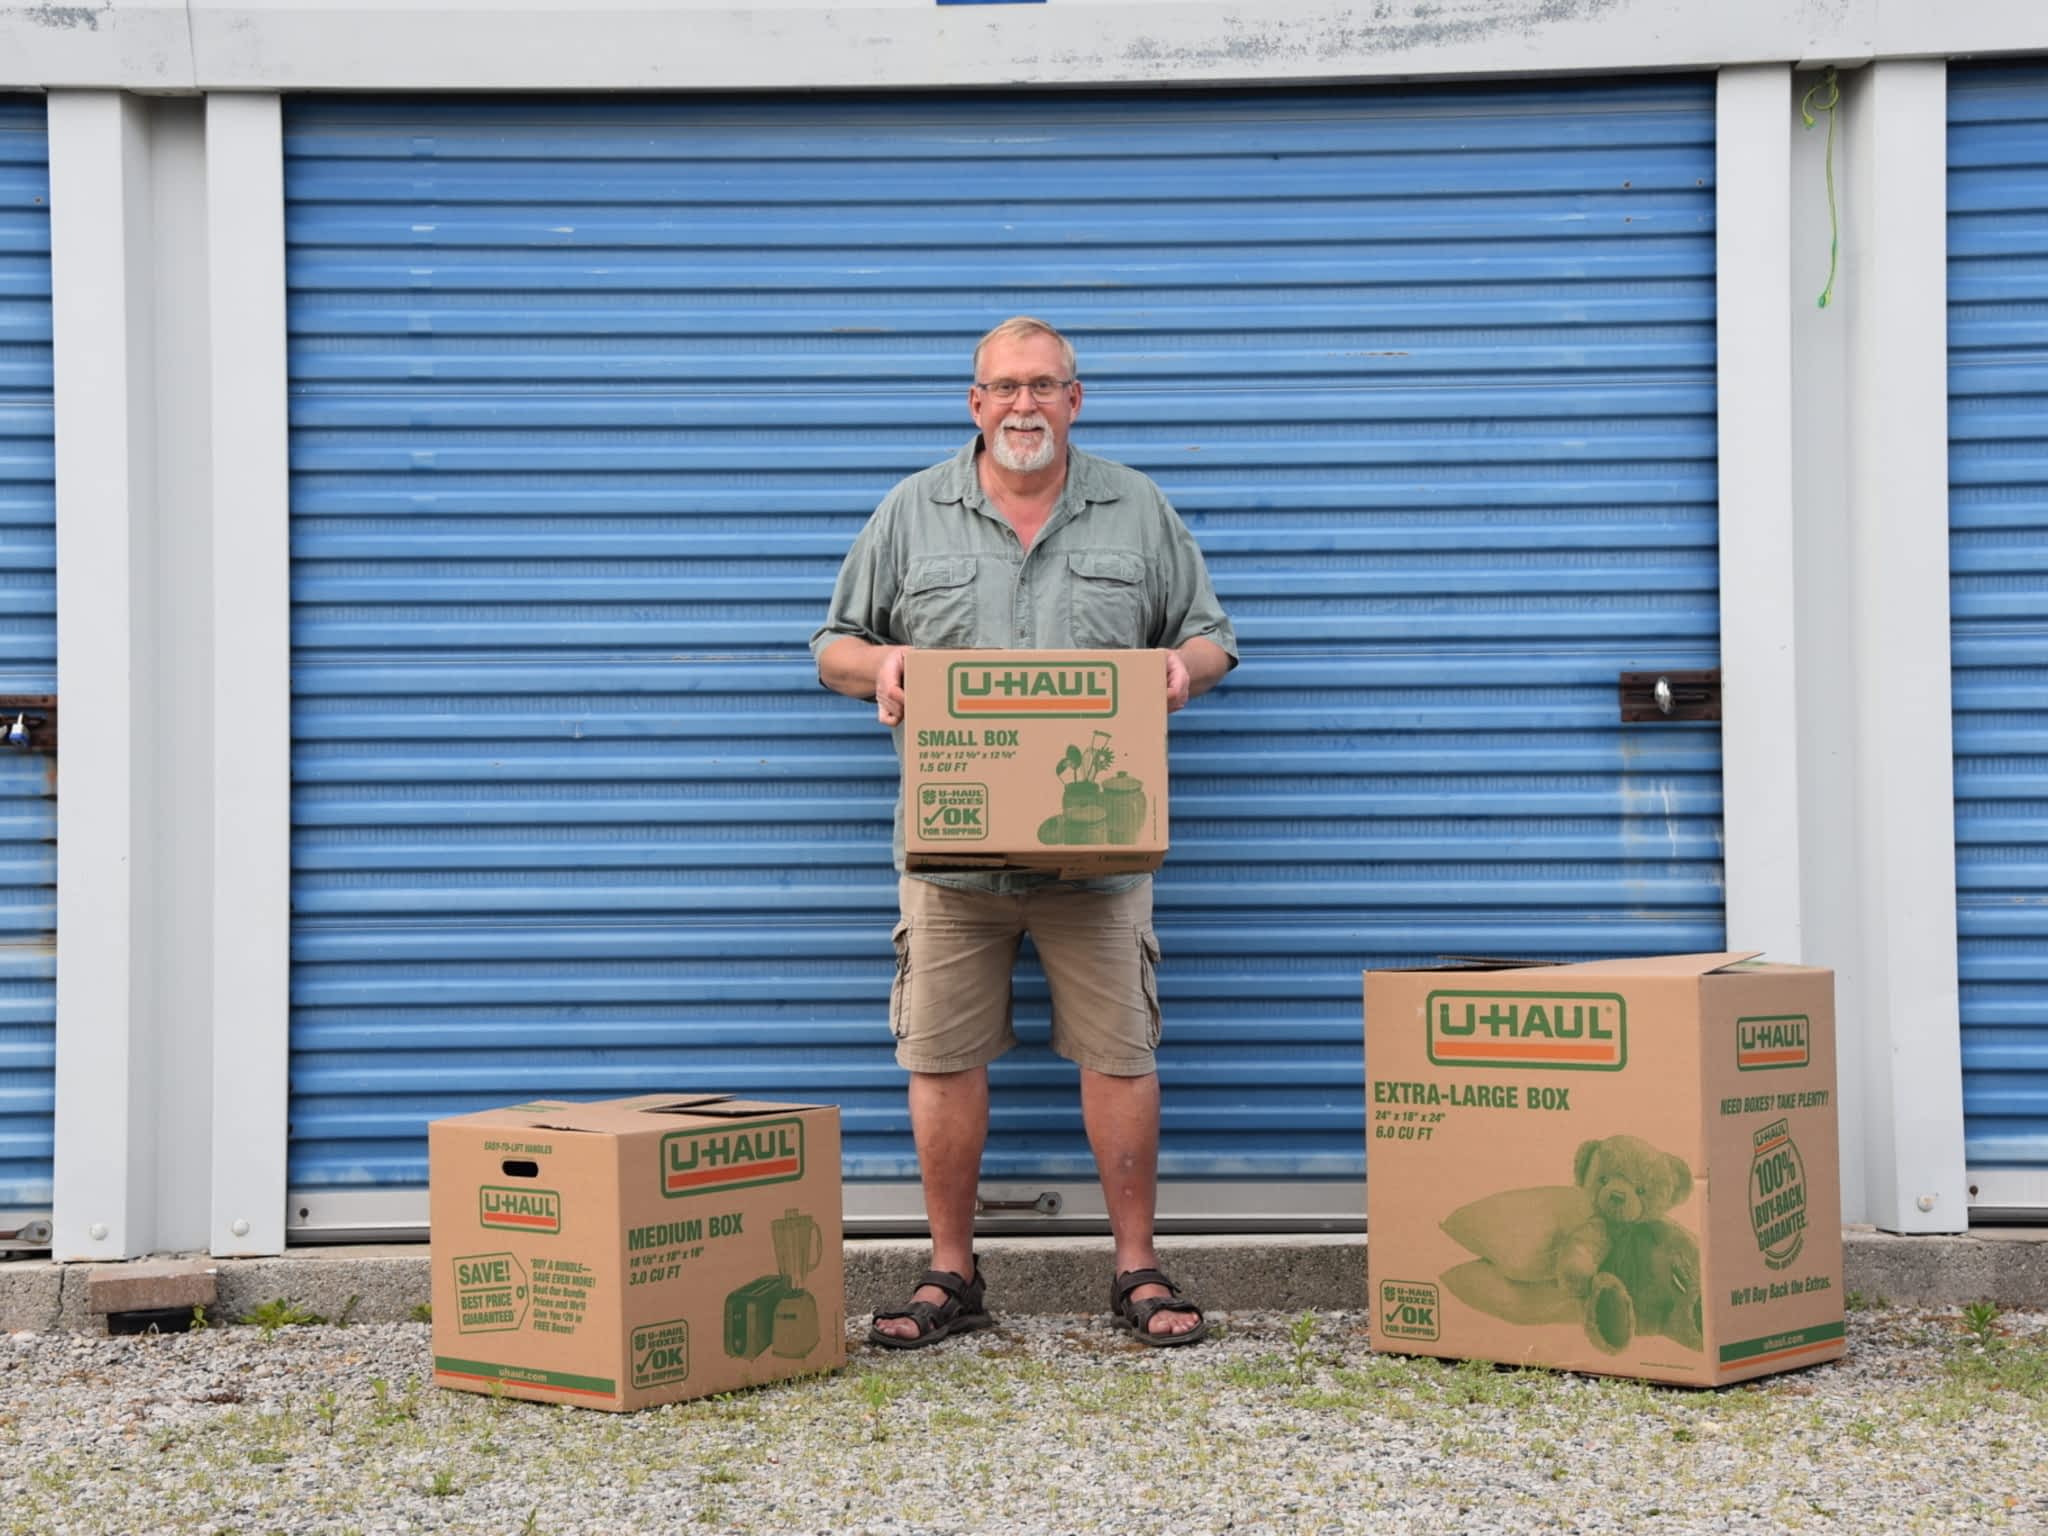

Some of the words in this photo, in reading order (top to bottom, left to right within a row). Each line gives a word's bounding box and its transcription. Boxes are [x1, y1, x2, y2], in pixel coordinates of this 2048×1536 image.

[960, 671, 1107, 696] U-HAUL
[918, 730, 978, 746] SMALL
[984, 730, 1019, 746] BOX
[955, 751, 964, 759] 12
[991, 751, 1000, 759] 12
[919, 762, 934, 772] 1.5
[937, 762, 952, 772] CU
[954, 762, 968, 772] FT
[943, 808, 982, 825] OK
[1440, 1003, 1613, 1039] U-HAUL
[1741, 1024, 1805, 1049] U-HAUL
[1374, 1081, 1519, 1109] EXTRA-LARGE
[1527, 1087, 1570, 1111] BOX
[1720, 1098, 1742, 1115] NEED
[1744, 1095, 1775, 1112] BOXES?
[1777, 1093, 1796, 1109] TAKE
[1798, 1090, 1829, 1107] PLENTY!
[1376, 1111, 1391, 1121] 24"
[1394, 1113, 1399, 1121] x
[1420, 1114, 1426, 1122] x
[1429, 1113, 1446, 1122] 24"
[1376, 1125, 1394, 1138] 6.0
[1398, 1126, 1414, 1140] CU
[1417, 1127, 1433, 1140] FT
[671, 1129, 795, 1171] U-HAUL
[1755, 1148, 1796, 1197] 100%
[484, 1193, 555, 1217] U-HAUL
[1755, 1183, 1803, 1228] BUY-BACK
[629, 1219, 702, 1251] MEDIUM
[709, 1213, 743, 1238] BOX
[658, 1256, 664, 1264] x
[459, 1260, 511, 1285] SAVE!
[532, 1272, 550, 1282] SAVE
[551, 1274, 571, 1284] EVEN
[572, 1276, 596, 1288] MORE!
[629, 1271, 647, 1286] 3.0
[650, 1268, 665, 1282] CU
[667, 1264, 681, 1279] FT
[461, 1295, 483, 1310] BEST
[486, 1293, 512, 1308] PRICE
[1398, 1296, 1435, 1305] BOXES
[1752, 1287, 1768, 1304] Buy
[1769, 1281, 1788, 1299] Back
[1791, 1280, 1803, 1295] the
[533, 1320, 550, 1330] FREE
[1402, 1306, 1434, 1326] OK
[648, 1336, 684, 1349] BOXES
[652, 1346, 683, 1369] OK
[498, 1368, 548, 1384] uhaul.com
